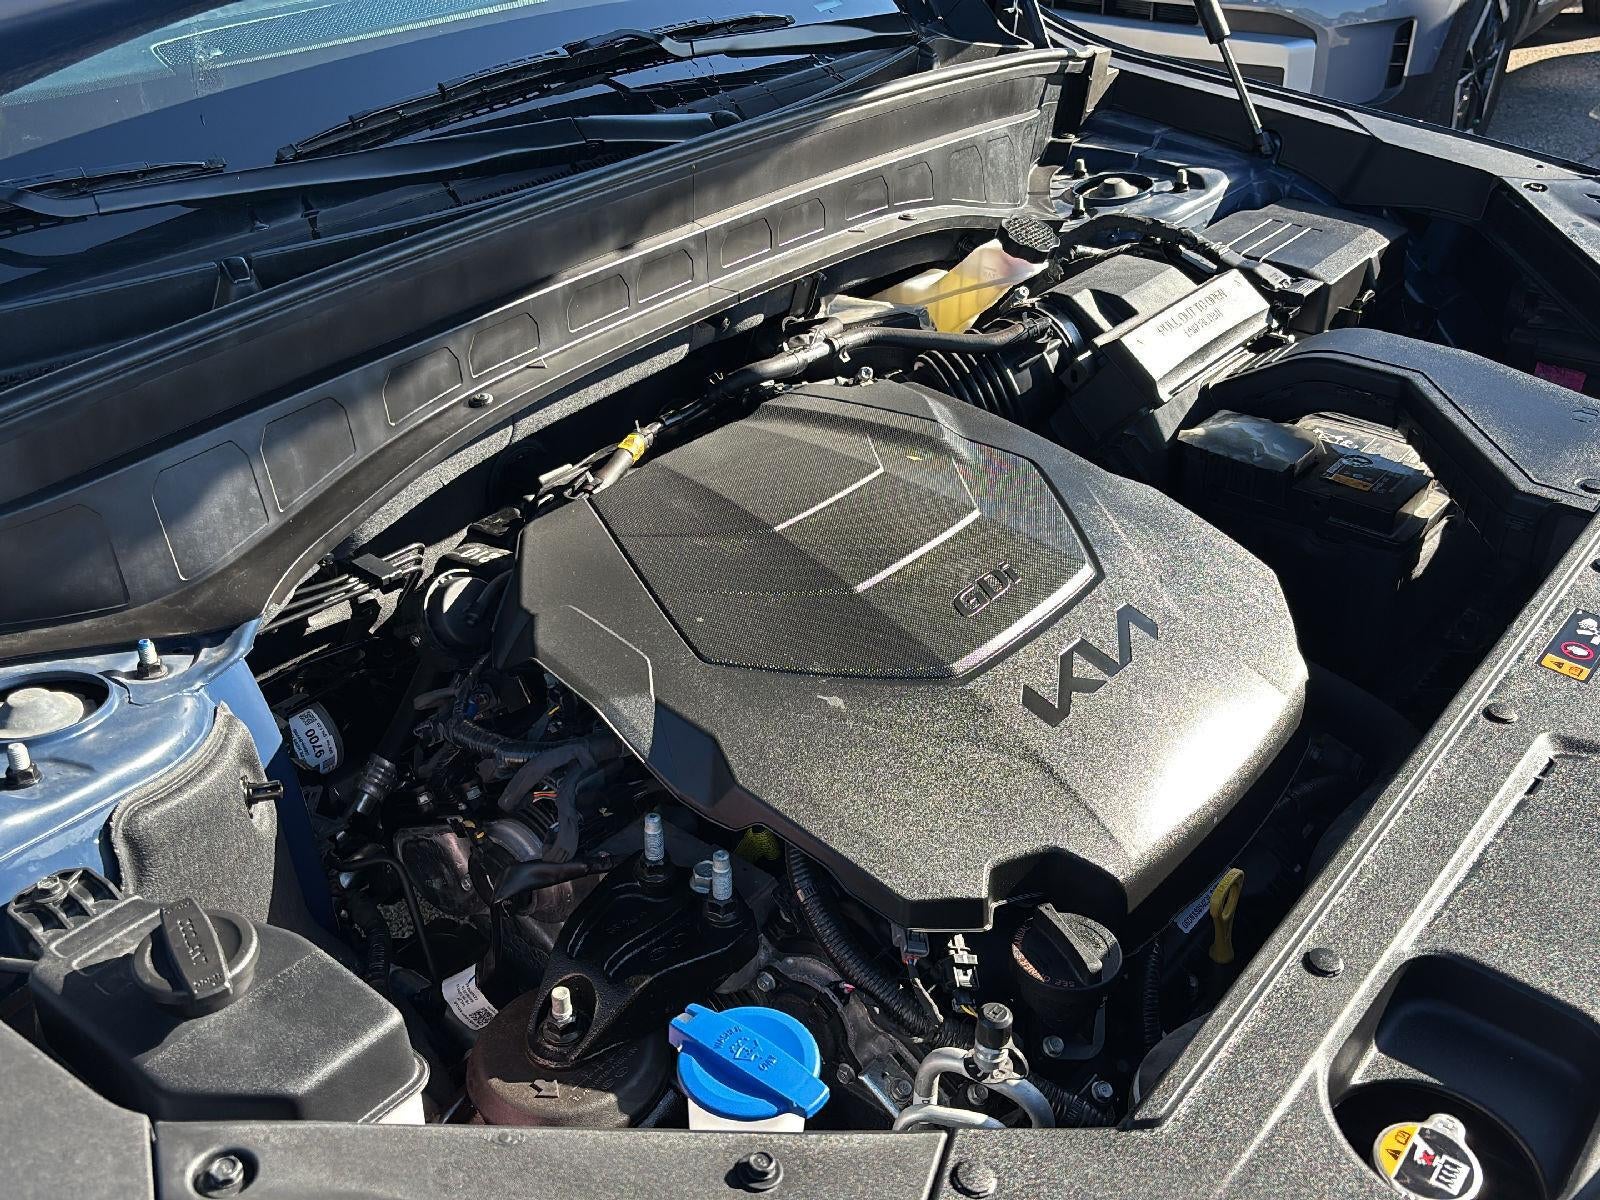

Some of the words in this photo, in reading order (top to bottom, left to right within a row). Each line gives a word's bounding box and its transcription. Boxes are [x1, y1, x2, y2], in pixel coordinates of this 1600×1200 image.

[1178, 306, 1196, 324] OUT
[1195, 299, 1208, 315] TO
[304, 728, 326, 759] 9700
